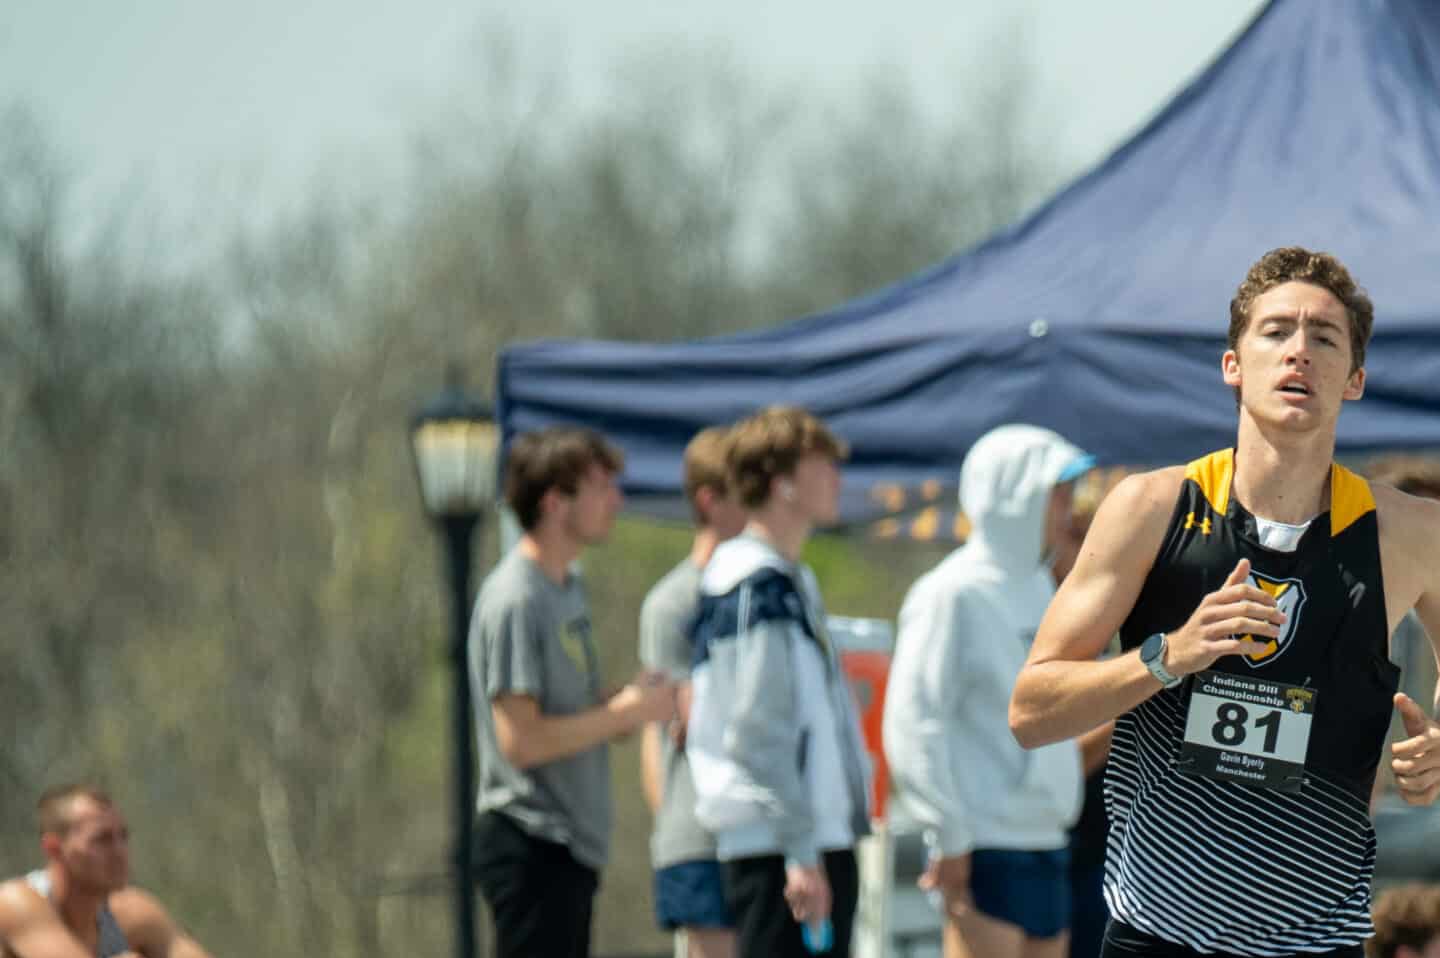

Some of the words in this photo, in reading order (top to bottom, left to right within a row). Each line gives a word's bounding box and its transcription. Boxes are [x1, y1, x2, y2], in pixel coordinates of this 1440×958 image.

[1213, 675, 1256, 690] Indiana
[1203, 684, 1284, 706] Championship
[1211, 702, 1282, 754] 81
[1215, 764, 1266, 780] Manchester
